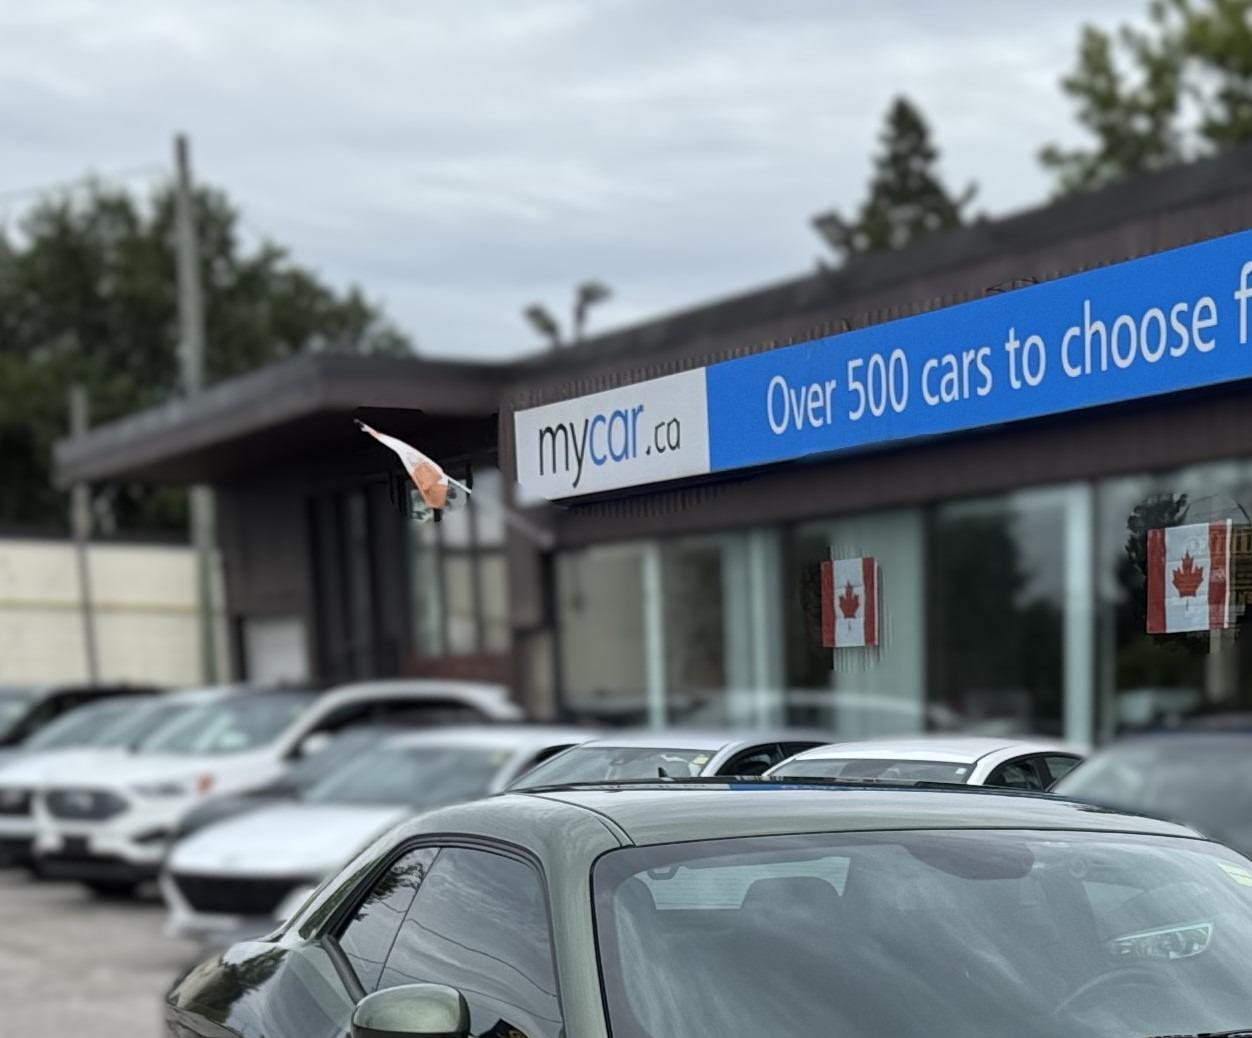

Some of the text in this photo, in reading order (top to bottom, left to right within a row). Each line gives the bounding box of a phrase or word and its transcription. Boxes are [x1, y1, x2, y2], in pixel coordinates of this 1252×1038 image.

[766, 375, 837, 435] Over
[847, 344, 910, 421] 500
[920, 345, 993, 405] cars
[1004, 326, 1046, 390] to
[1060, 299, 1218, 378] choose
[538, 404, 681, 488] mycar.ca
